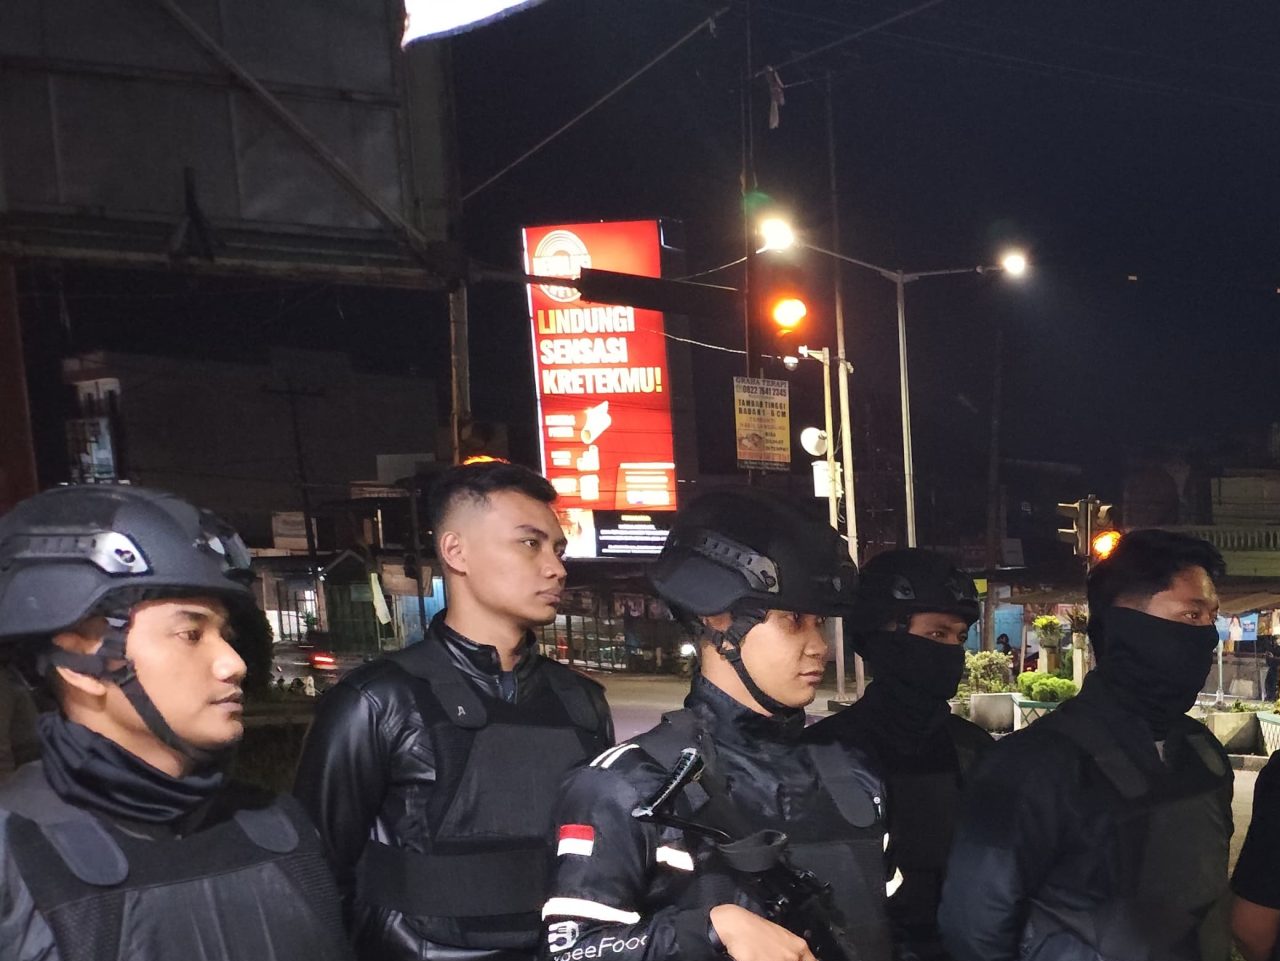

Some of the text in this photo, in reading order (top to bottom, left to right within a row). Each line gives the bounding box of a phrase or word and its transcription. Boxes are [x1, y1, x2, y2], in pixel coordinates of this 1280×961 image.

[537, 305, 636, 334] LINDUNGI
[539, 337, 628, 365] SENSASI
[542, 367, 663, 395] KRETEKMU!
